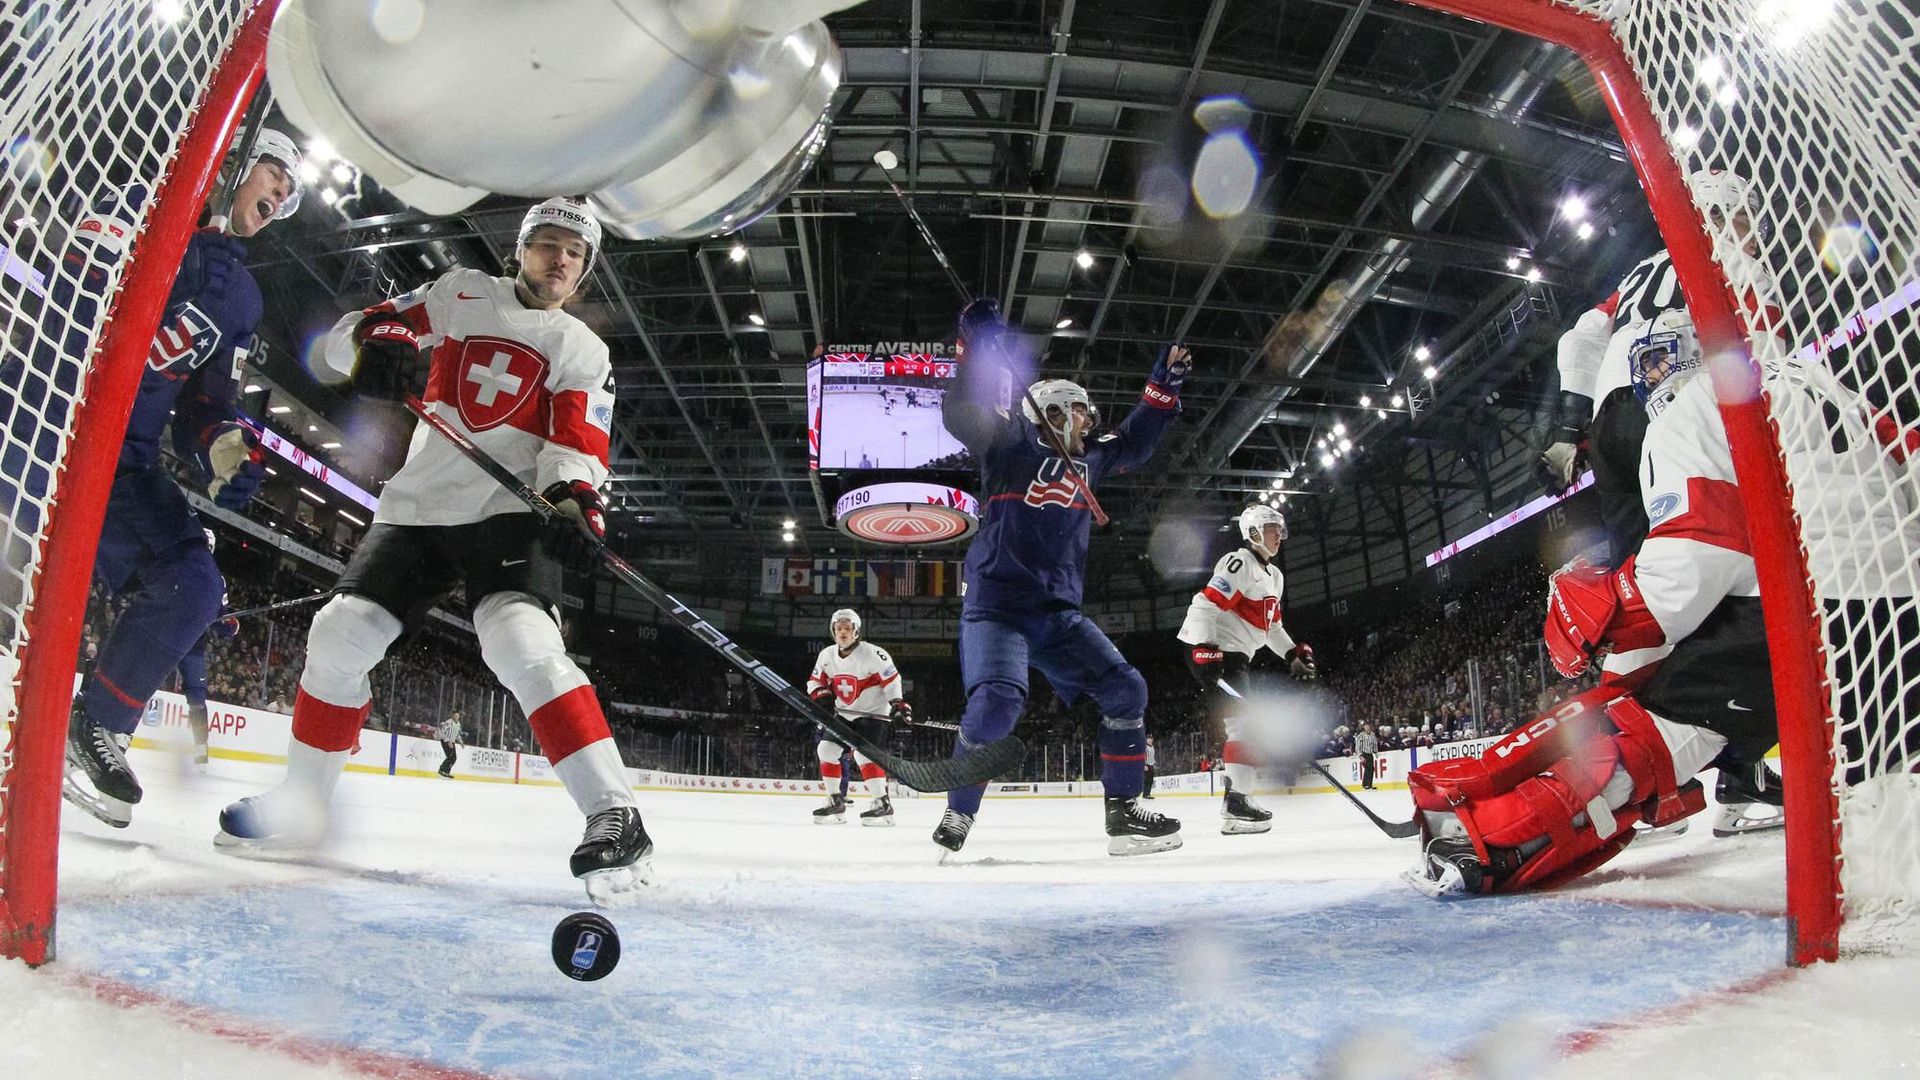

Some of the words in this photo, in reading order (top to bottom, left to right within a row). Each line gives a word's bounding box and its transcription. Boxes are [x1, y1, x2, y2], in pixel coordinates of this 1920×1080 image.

[828, 344, 872, 352] CENTRE
[875, 342, 944, 354] AVENIR
[890, 366, 897, 374] 1
[923, 366, 930, 375] 0
[1618, 572, 1632, 599] CCM
[1331, 600, 1348, 616] 113
[638, 626, 658, 640] 109
[665, 594, 792, 692] TRUE
[876, 650, 887, 661] 6
[208, 711, 246, 736] APP
[1496, 701, 1584, 759] CCM
